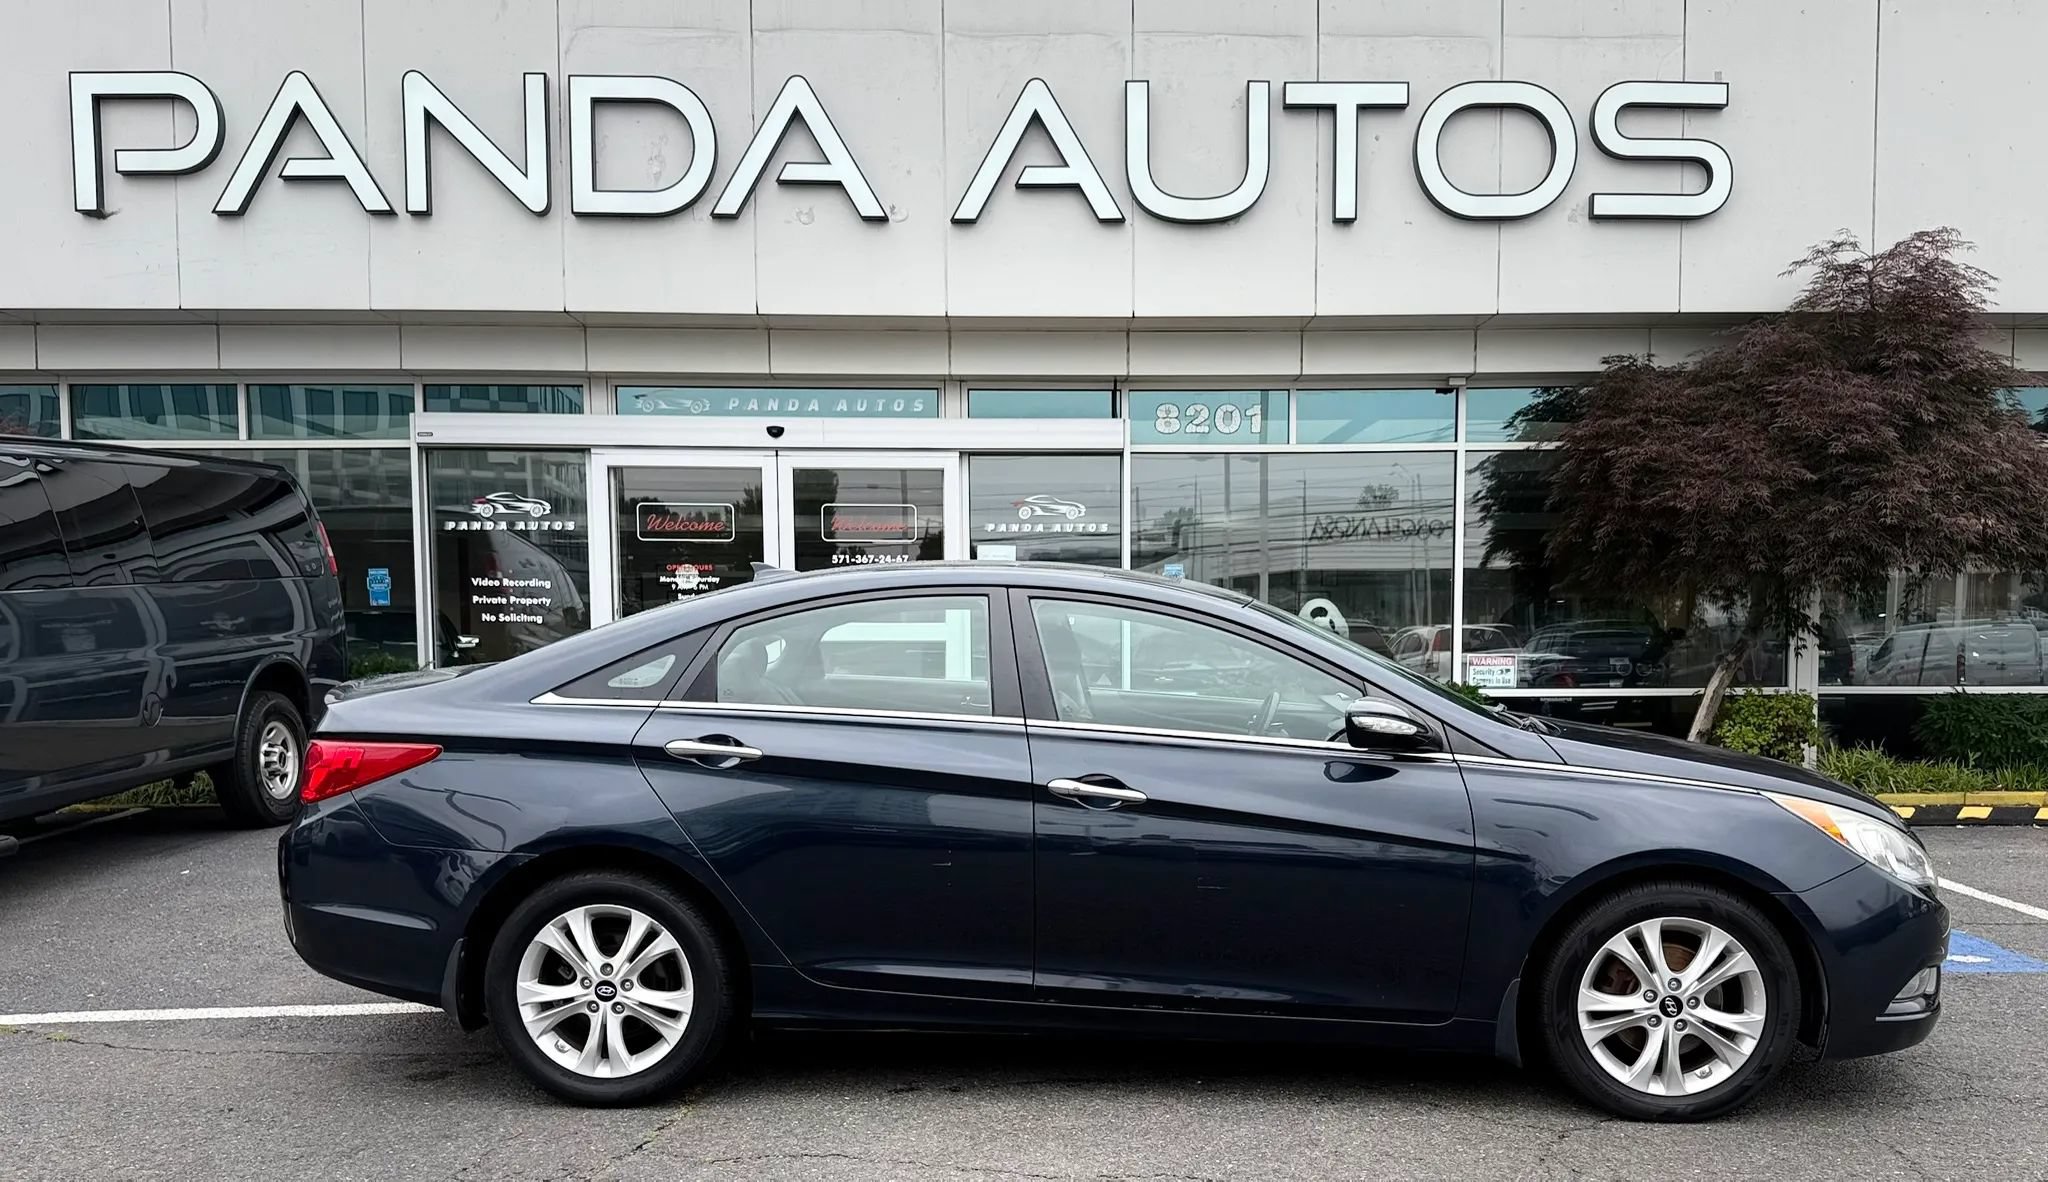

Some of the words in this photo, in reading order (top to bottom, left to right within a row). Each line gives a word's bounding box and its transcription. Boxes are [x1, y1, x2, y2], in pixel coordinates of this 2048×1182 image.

[68, 70, 889, 222] PANDA
[950, 76, 1734, 223] AUTOS
[728, 398, 819, 412] PANDA
[836, 399, 924, 412] AUTOS
[1154, 403, 1262, 435] 8201
[444, 521, 507, 531] PANDA
[514, 521, 575, 531] AUTOS
[647, 514, 725, 530] Welcome
[831, 513, 907, 531] Welcome
[985, 523, 1044, 533] PANDA
[1050, 523, 1108, 533] AUTOS
[831, 554, 909, 564] 571-367-24-67
[471, 578, 500, 587] Video
[502, 578, 552, 589] Recording
[472, 595, 507, 605] Private
[509, 595, 552, 606] Property
[481, 613, 497, 622] No
[498, 613, 543, 624] Soliciting
[1472, 657, 1512, 665] WARNING
[1472, 668, 1496, 676] Security
